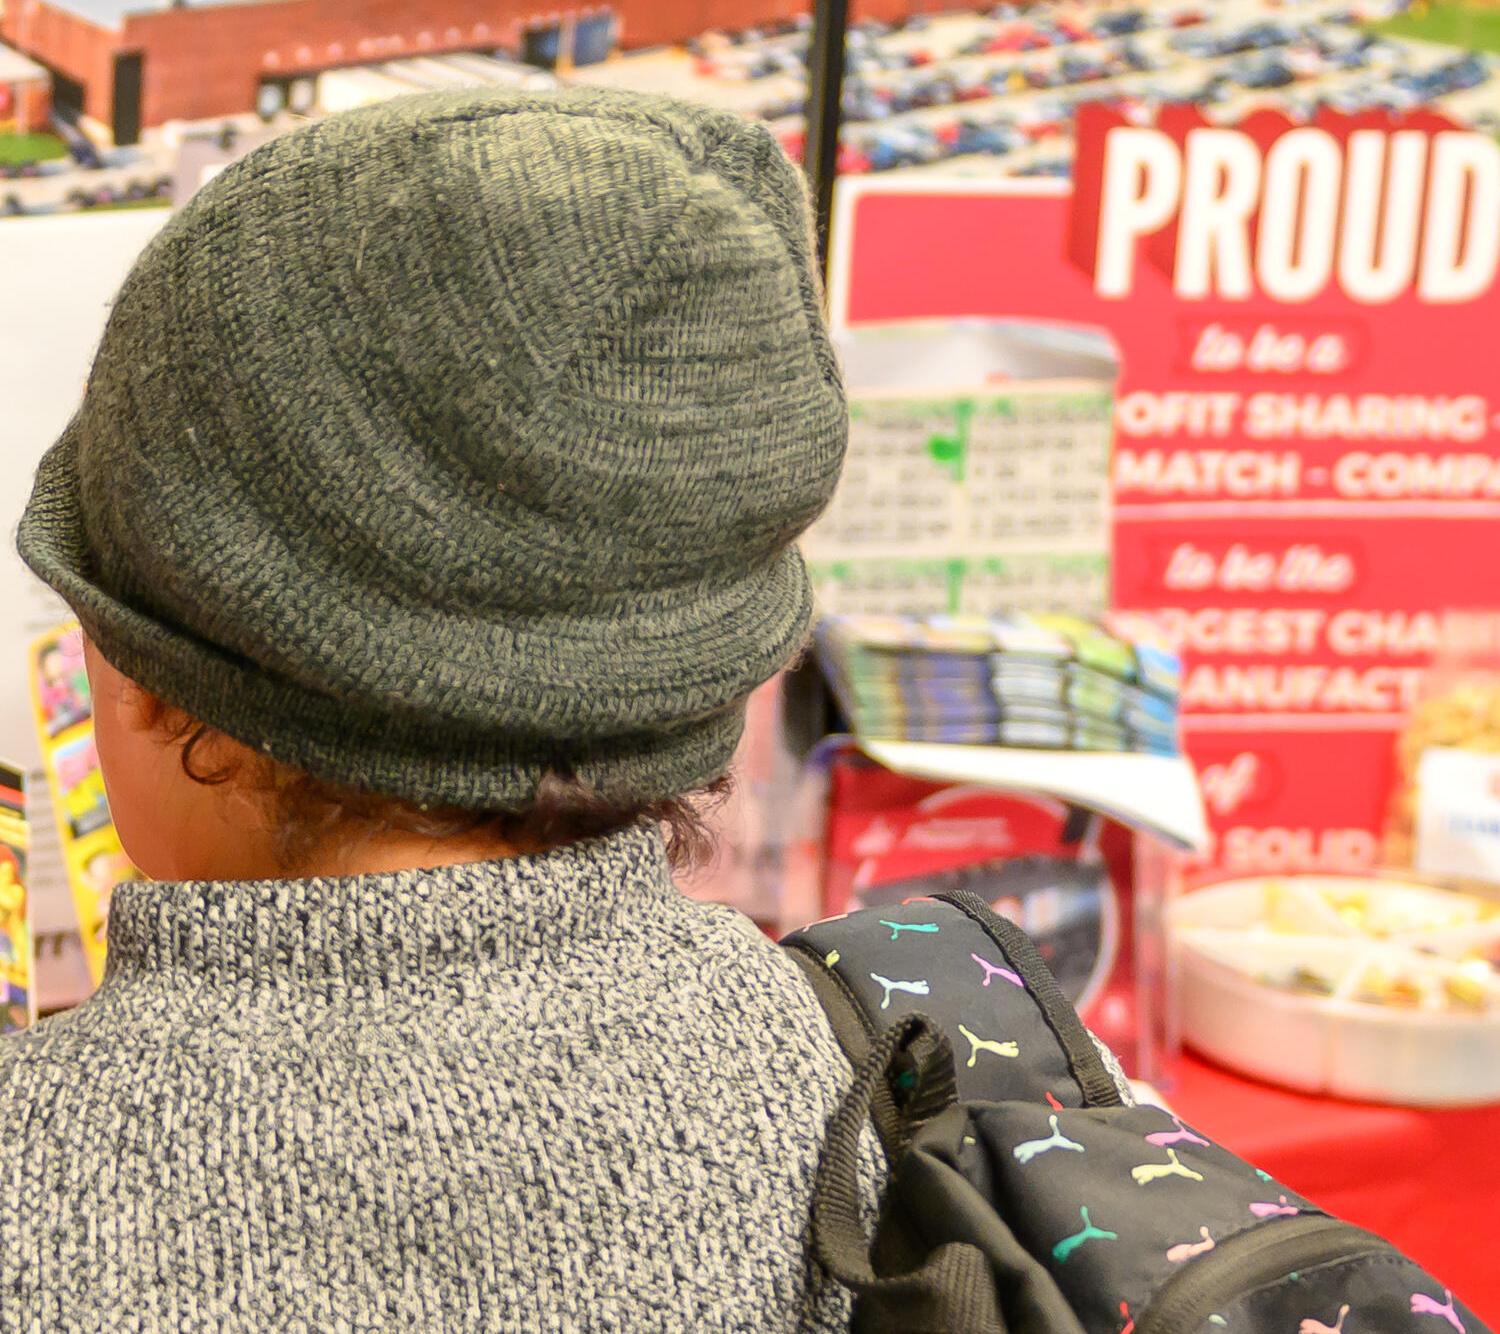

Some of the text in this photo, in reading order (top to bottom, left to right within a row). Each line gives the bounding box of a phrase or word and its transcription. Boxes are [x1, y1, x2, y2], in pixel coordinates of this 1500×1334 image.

[1116, 393, 1240, 437] OFIT
[1244, 395, 1490, 442] SHARING
[1115, 450, 1299, 497] MATCH
[1157, 607, 1325, 655] GEST
[1180, 666, 1420, 711] ANUFACT
[1221, 827, 1378, 868] SOLID
